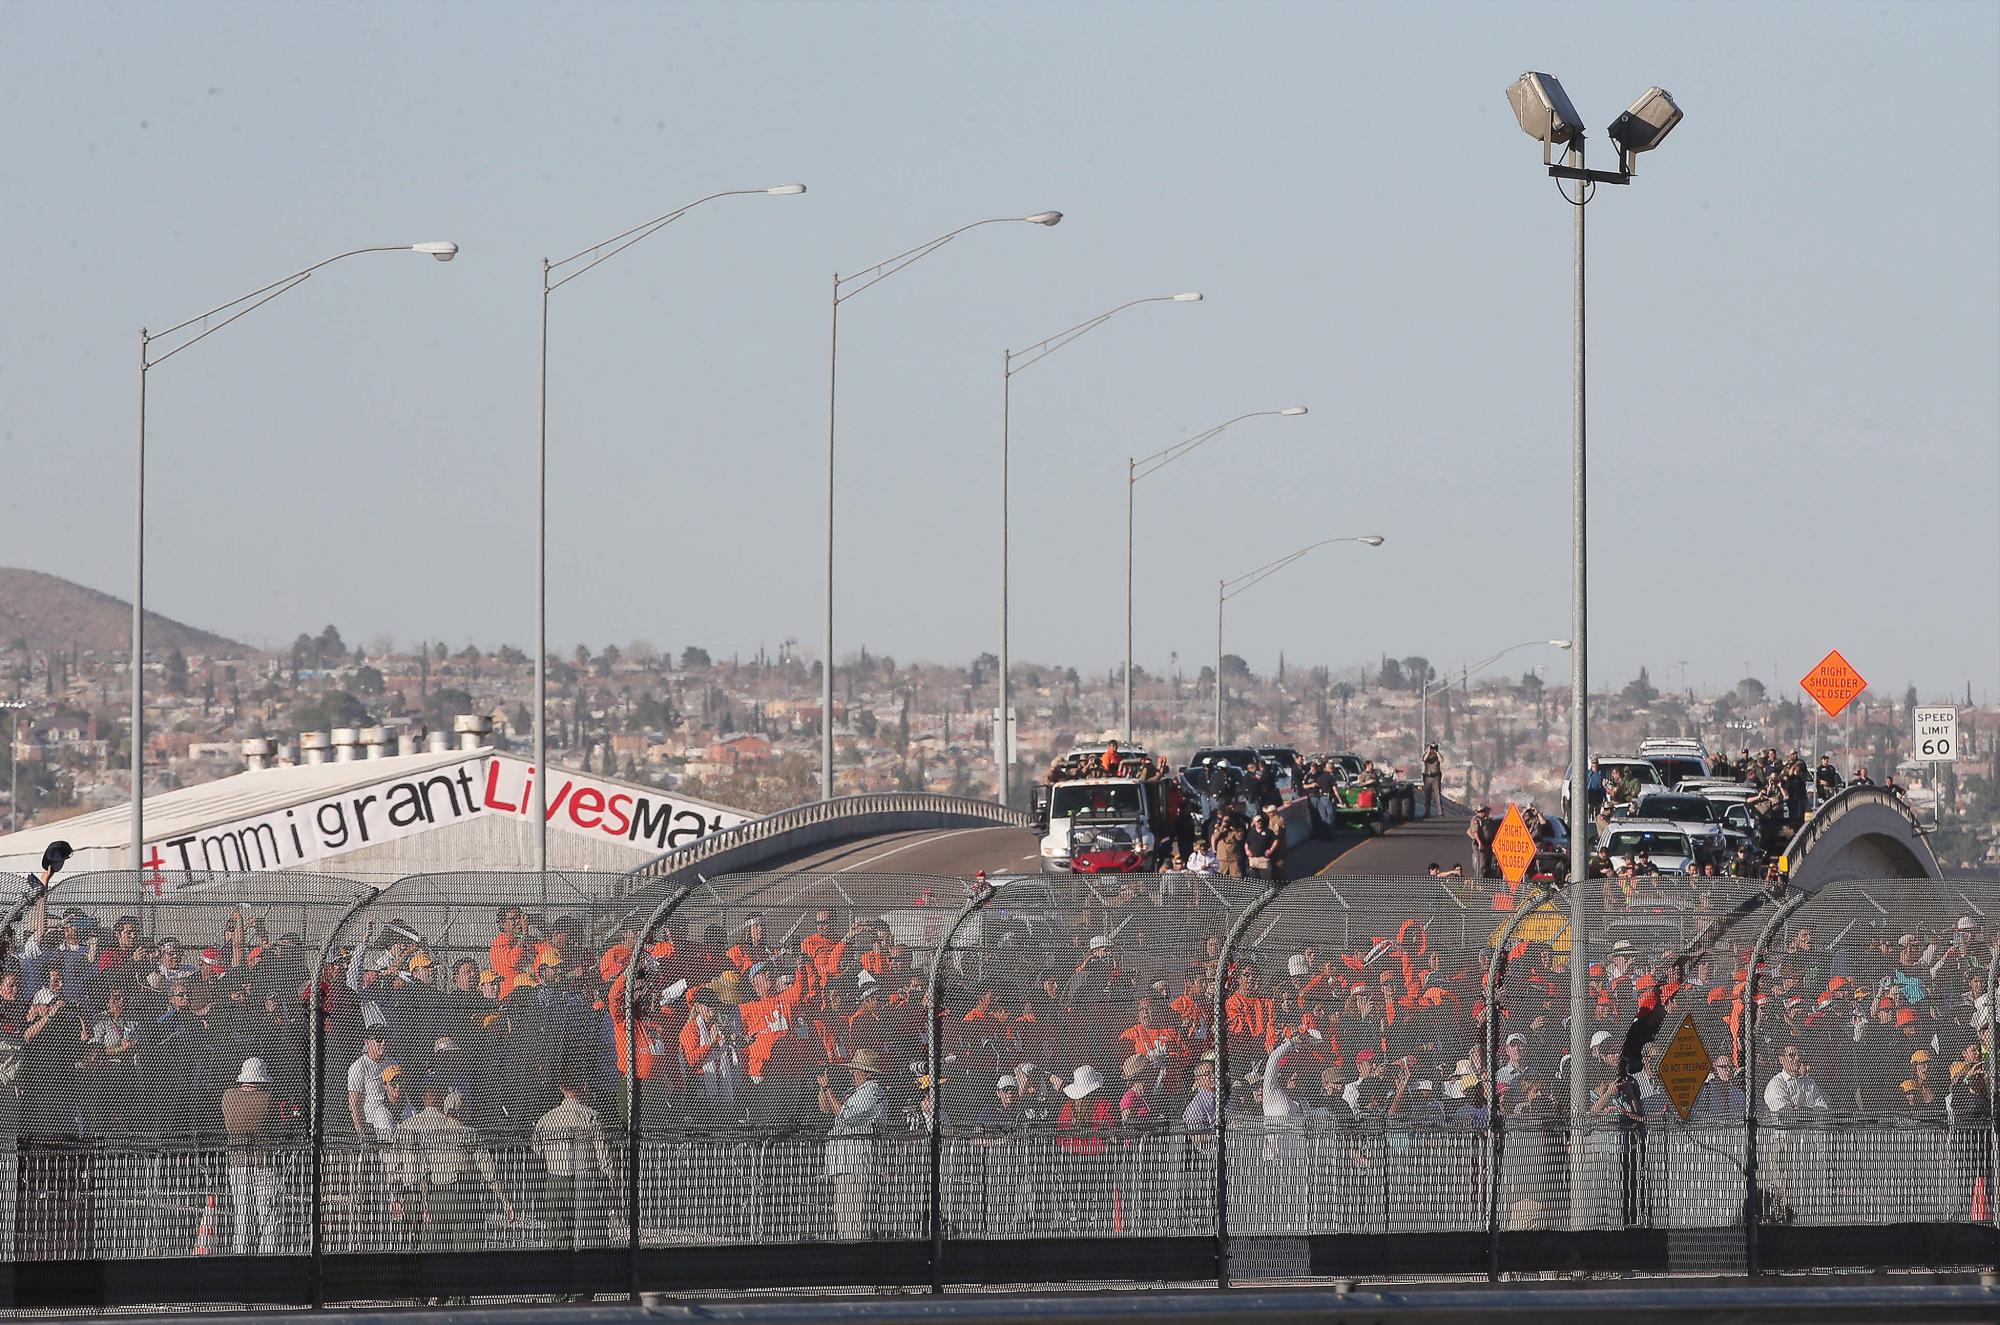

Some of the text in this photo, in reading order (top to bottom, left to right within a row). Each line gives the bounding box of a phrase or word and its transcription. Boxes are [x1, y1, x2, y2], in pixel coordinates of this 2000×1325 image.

[1820, 666, 1848, 677] RIGHT
[1809, 677, 1858, 688] SHOULDER
[1816, 688, 1851, 700] CLOSED
[1917, 713, 1954, 722] SPEED
[1921, 726, 1950, 735] LIMIT
[1922, 739, 1950, 755] 60
[1504, 824, 1523, 837] RIGHT
[1498, 839, 1529, 853] SHOULDER
[1502, 854, 1525, 869] CLOSED
[1670, 1063, 1681, 1072] NOT
[1682, 1062, 1709, 1072] TRESPASS
